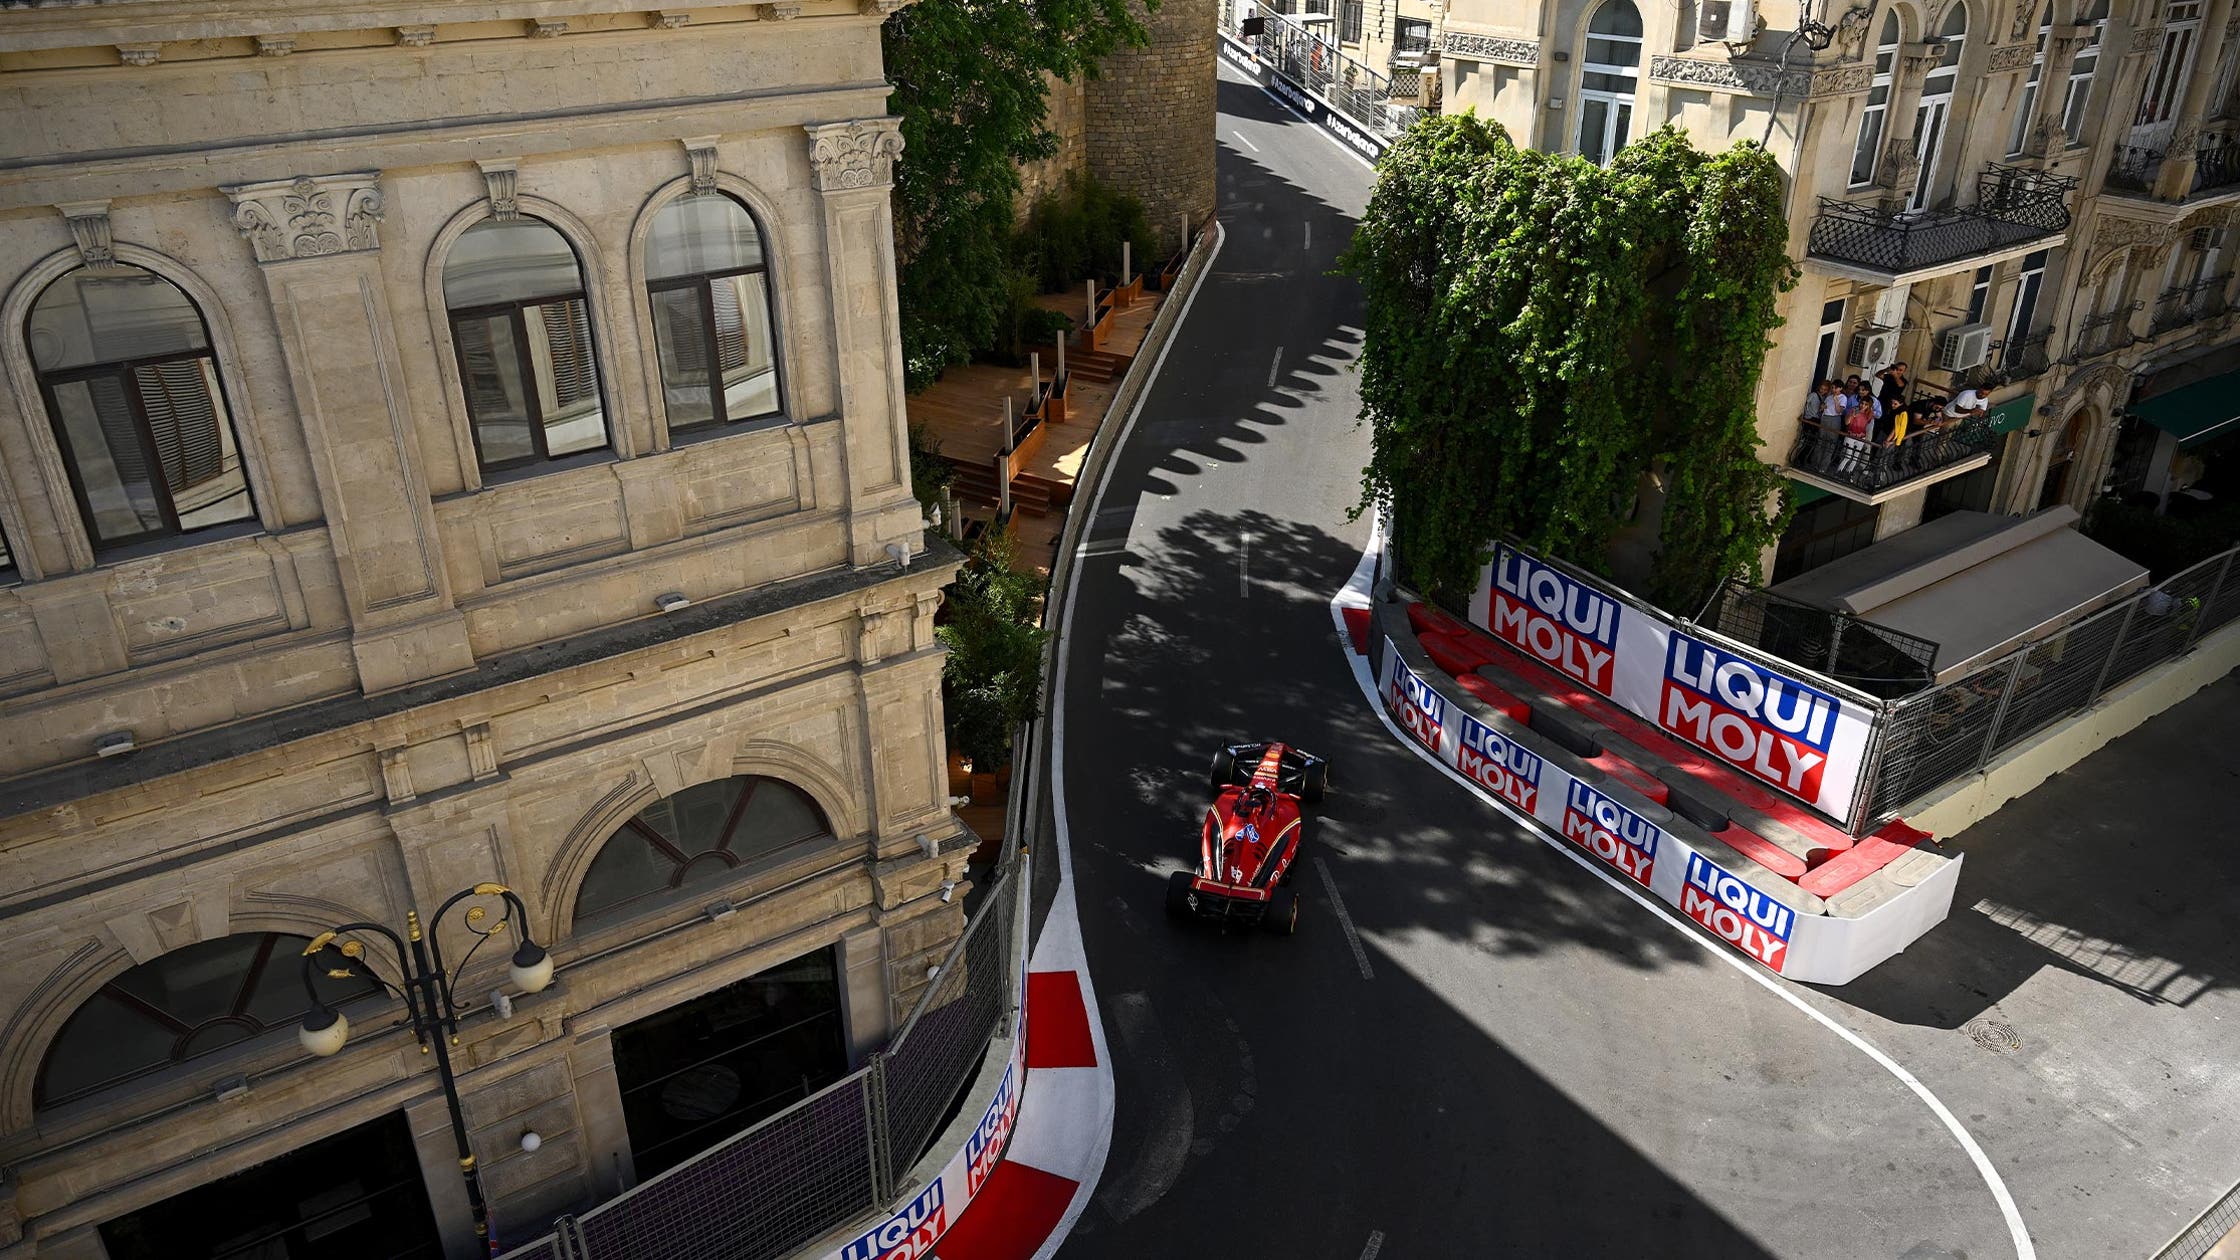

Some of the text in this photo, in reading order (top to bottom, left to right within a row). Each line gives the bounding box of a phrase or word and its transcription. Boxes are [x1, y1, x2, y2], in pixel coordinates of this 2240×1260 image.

[1496, 549, 1615, 645] LIQUI
[1493, 595, 1613, 687] MOLY
[1391, 692, 1440, 747] MOLY
[1394, 664, 1443, 719] LIQUI
[1671, 638, 1832, 745] LIQUI
[1463, 719, 1539, 784] LIQUI
[1665, 687, 1823, 793] MOLY
[1461, 754, 1537, 810] MOLY
[1572, 782, 1657, 853] LIQUI
[1567, 813, 1653, 883] MOLY
[1684, 888, 1787, 968] MOLY
[1689, 858, 1791, 938] LIQUI
[970, 1068, 1012, 1166] LIQUI
[970, 1095, 1014, 1190] MOLY
[847, 1183, 940, 1260] LIQUI
[885, 1207, 944, 1260] OLY
